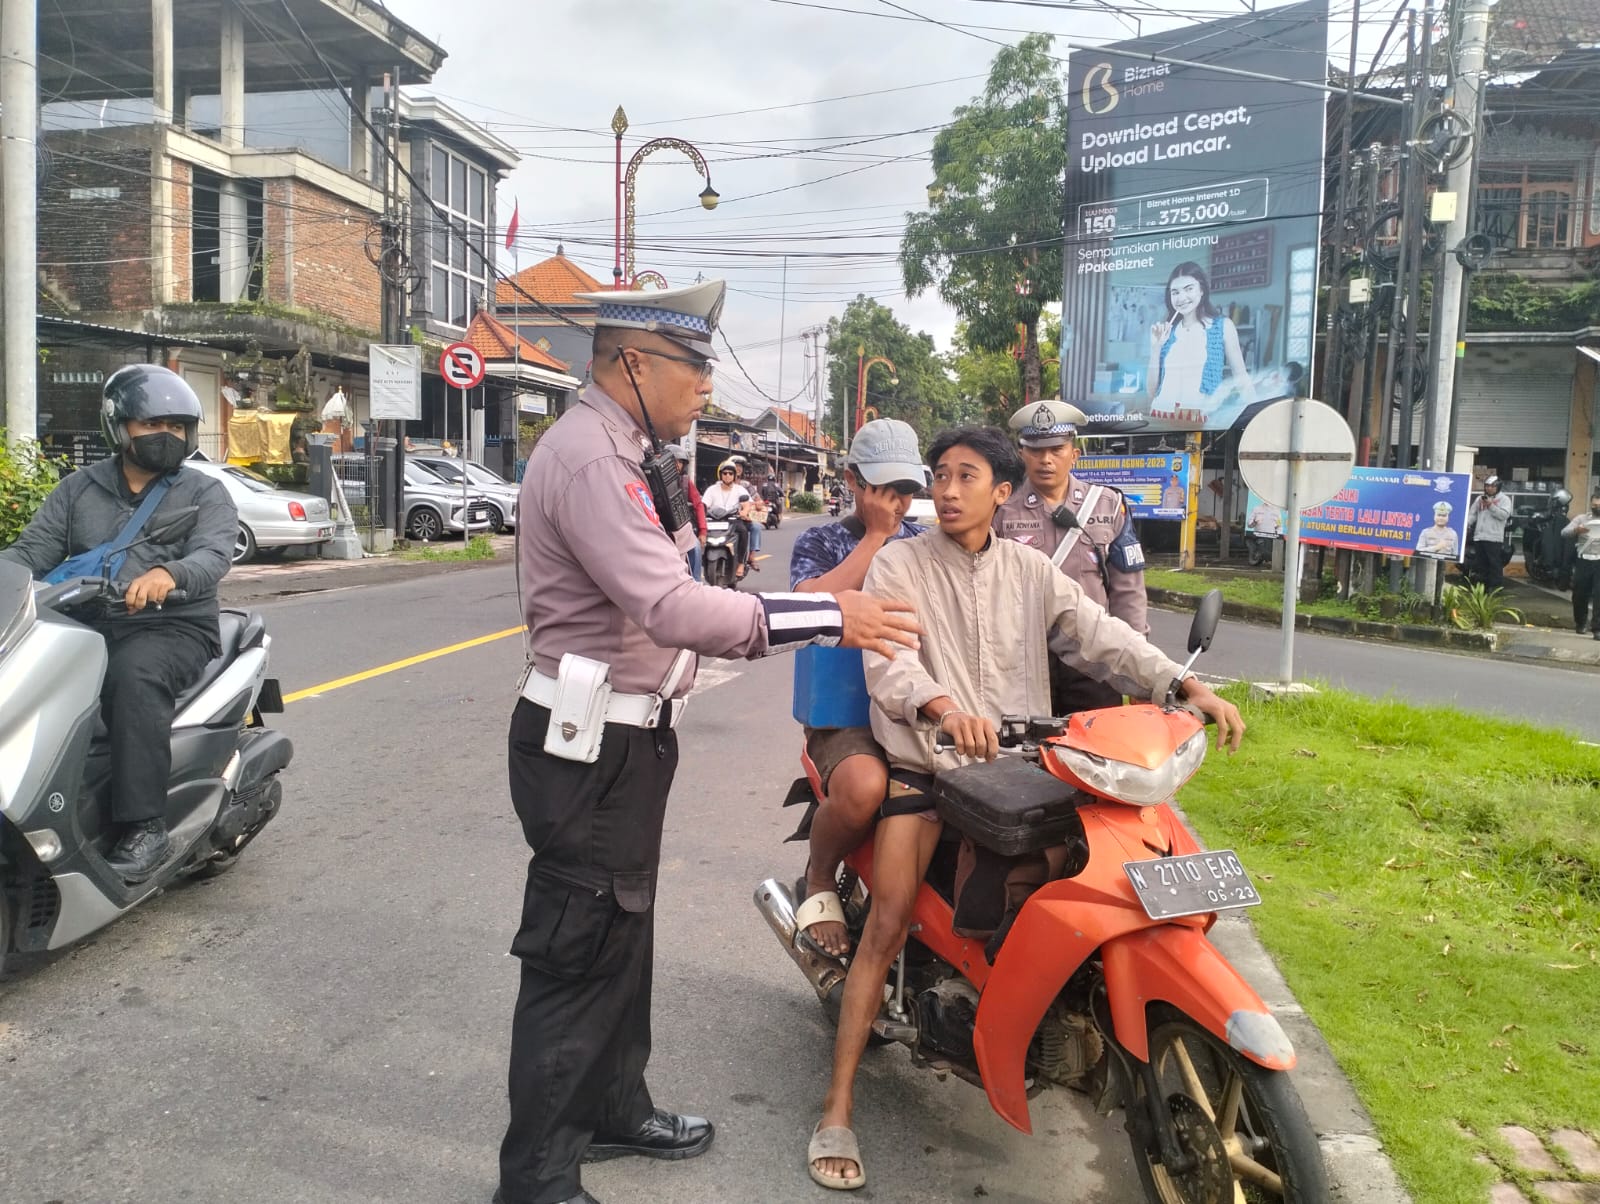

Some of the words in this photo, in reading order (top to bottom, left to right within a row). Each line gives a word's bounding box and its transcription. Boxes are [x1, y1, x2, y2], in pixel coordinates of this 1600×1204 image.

[1124, 63, 1170, 82] Biznet
[1123, 80, 1164, 98] Home
[1082, 117, 1178, 150] Download
[1183, 105, 1252, 132] Cepat,
[1081, 146, 1149, 174] Upload
[1154, 134, 1232, 161] Lancar.
[1147, 198, 1170, 209] Biznet
[1172, 195, 1195, 205] Home
[1196, 190, 1228, 203] Internet
[1084, 214, 1116, 234] 150
[1078, 243, 1160, 261] Sempurnakan
[1162, 234, 1219, 251] Hidupmu
[1078, 257, 1154, 275] #PakeBiznet
[1366, 475, 1399, 484] GIANYAR
[1325, 506, 1355, 521] TERTIB
[1358, 508, 1380, 524] LALU
[1381, 510, 1413, 528] LINTAS
[1306, 521, 1336, 532] ATURAN
[1338, 523, 1373, 536] BERLALU
[1374, 527, 1404, 539] LINTAS
[1154, 861, 1202, 886] 2710
